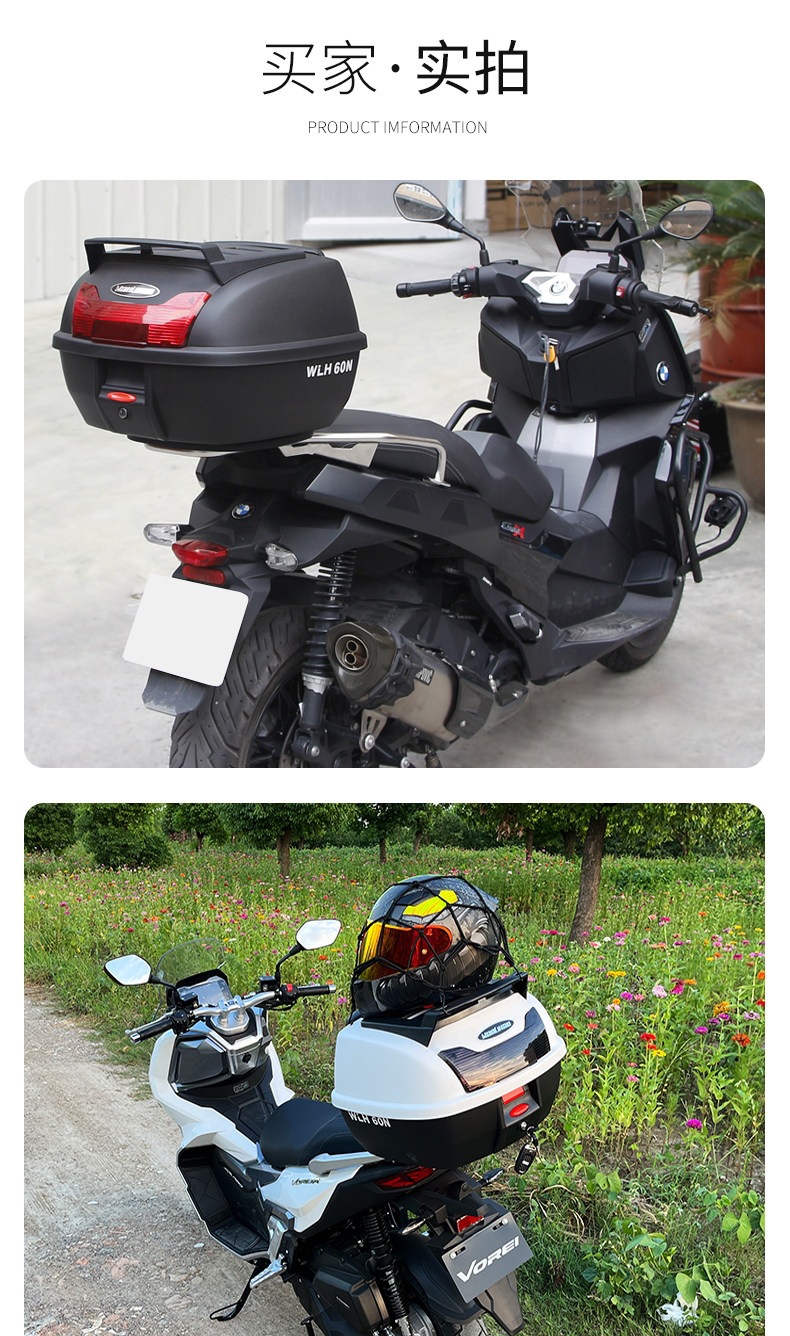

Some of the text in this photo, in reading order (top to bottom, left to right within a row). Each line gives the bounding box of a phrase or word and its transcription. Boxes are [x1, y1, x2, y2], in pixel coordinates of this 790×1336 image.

[306, 359, 353, 378] WLH 60N
[348, 1110, 391, 1128] WLH 60N
[456, 1235, 519, 1283] VOREI
